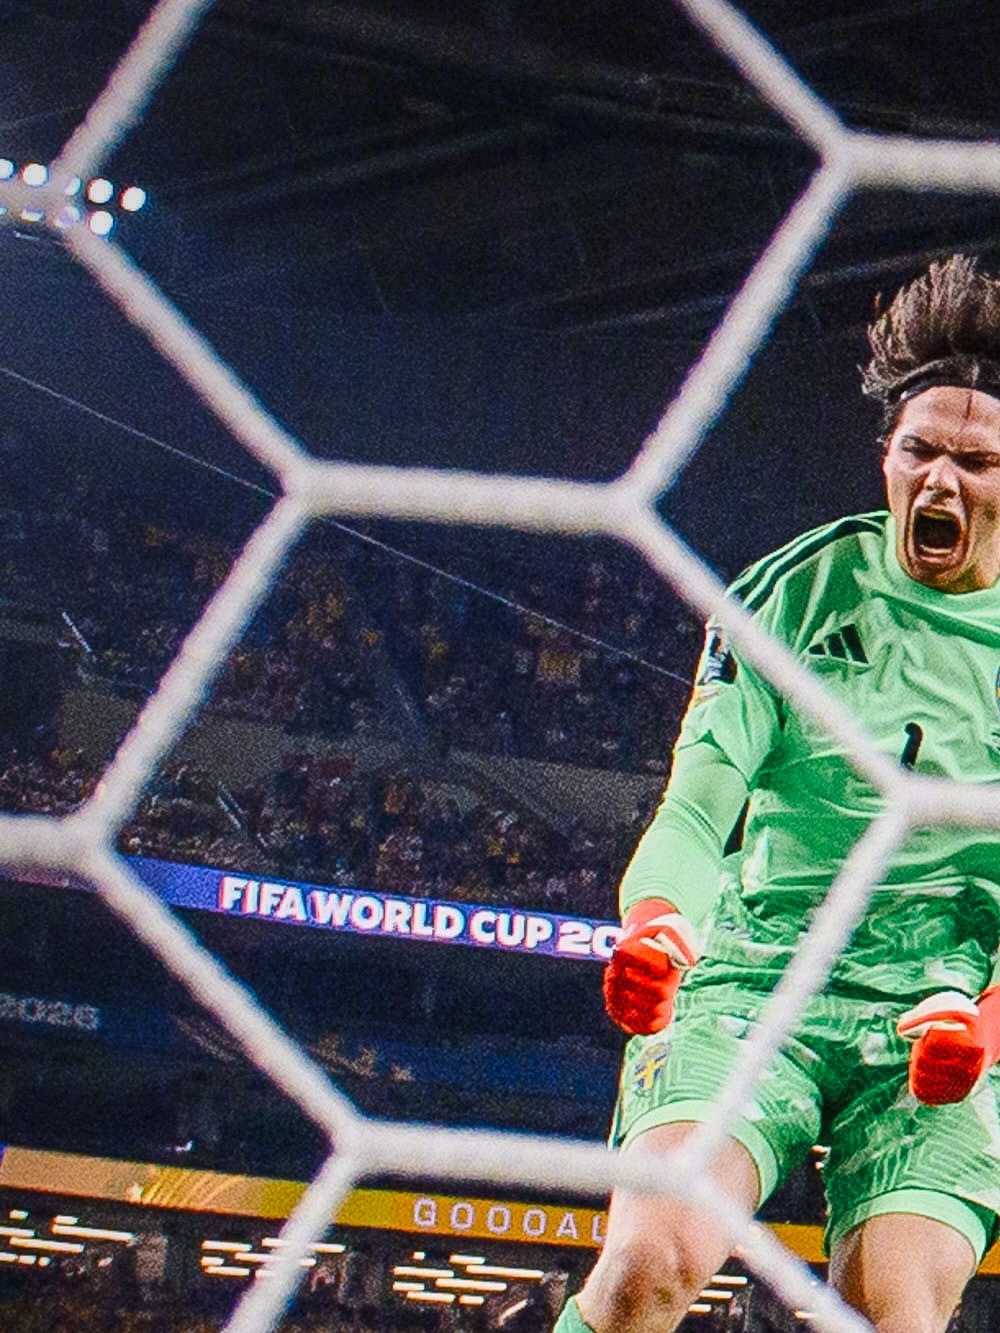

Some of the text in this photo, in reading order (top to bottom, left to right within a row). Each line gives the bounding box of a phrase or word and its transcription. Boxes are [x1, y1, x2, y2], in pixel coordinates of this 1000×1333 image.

[901, 722, 923, 770] 1
[219, 875, 622, 958] FIFA WORLD CUP 20
